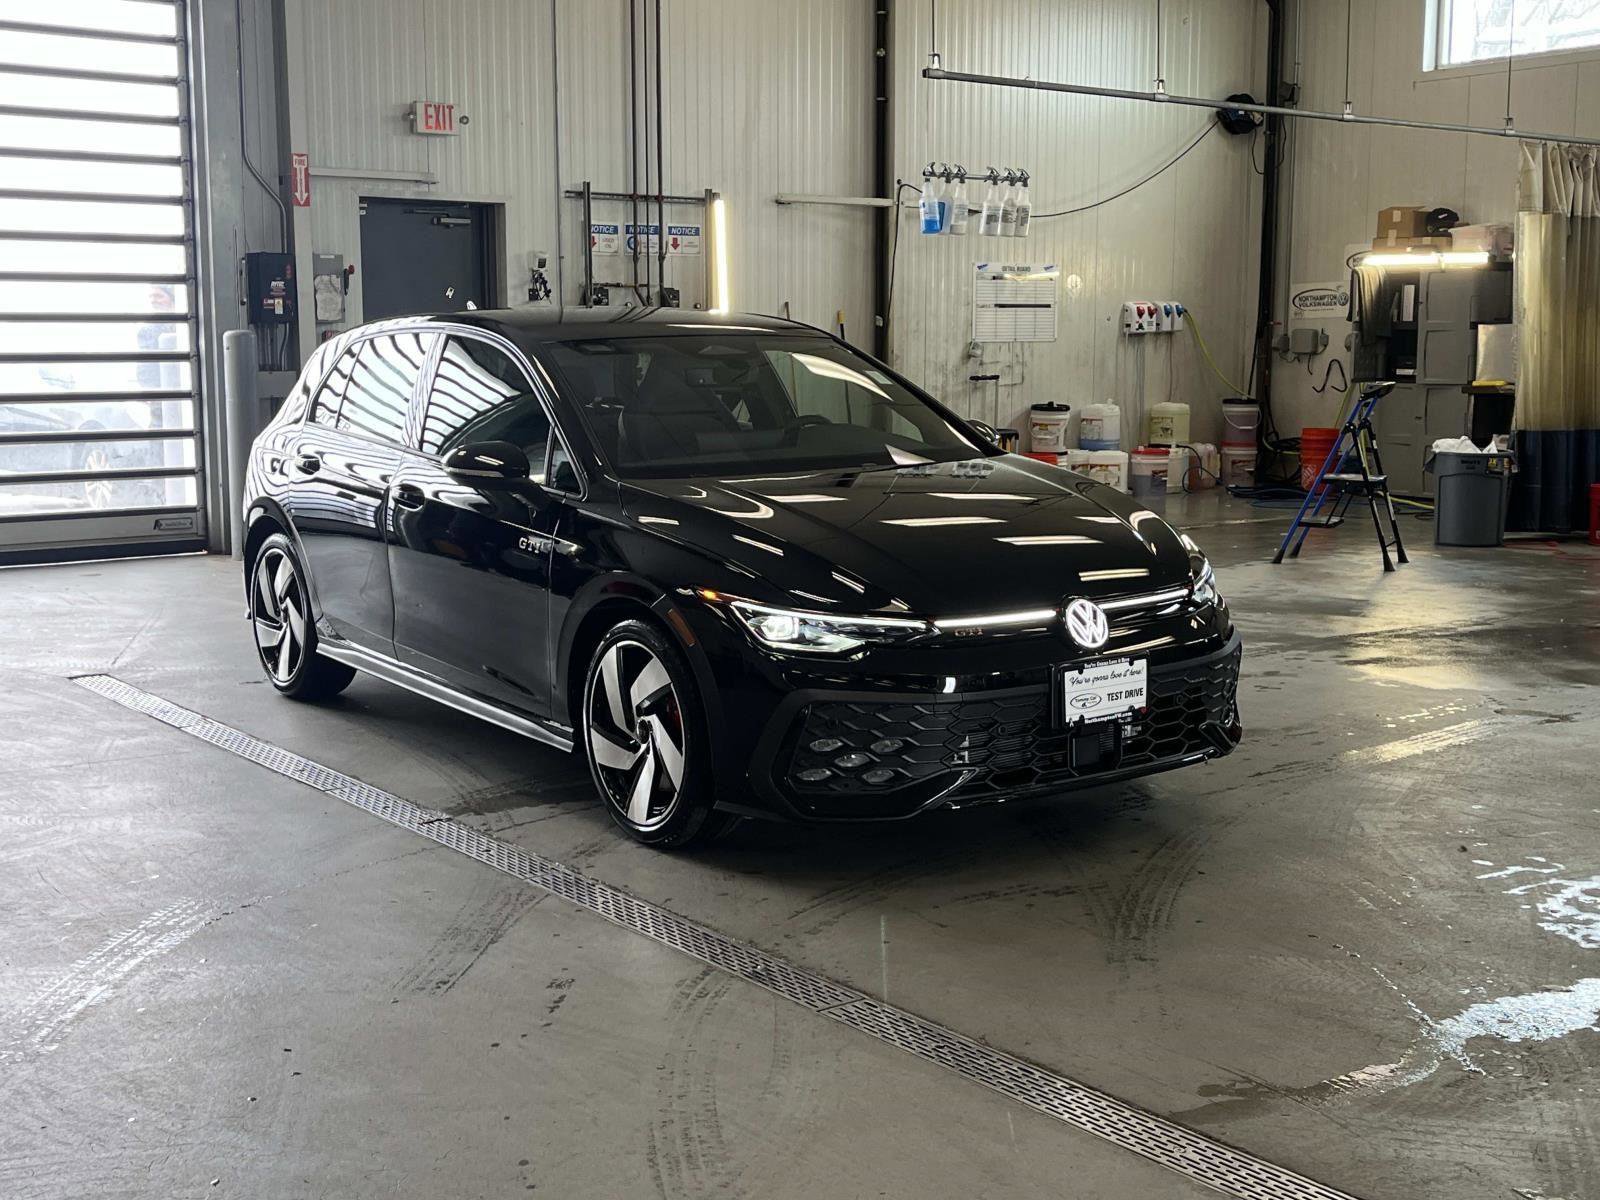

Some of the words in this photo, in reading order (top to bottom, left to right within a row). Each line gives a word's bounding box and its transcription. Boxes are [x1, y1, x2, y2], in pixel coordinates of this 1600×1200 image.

[424, 103, 454, 130] EXIT
[671, 227, 696, 235] NOTICE
[954, 627, 984, 637] GTI
[1107, 691, 1123, 702] TEST
[1125, 687, 1144, 699] DRIVE
